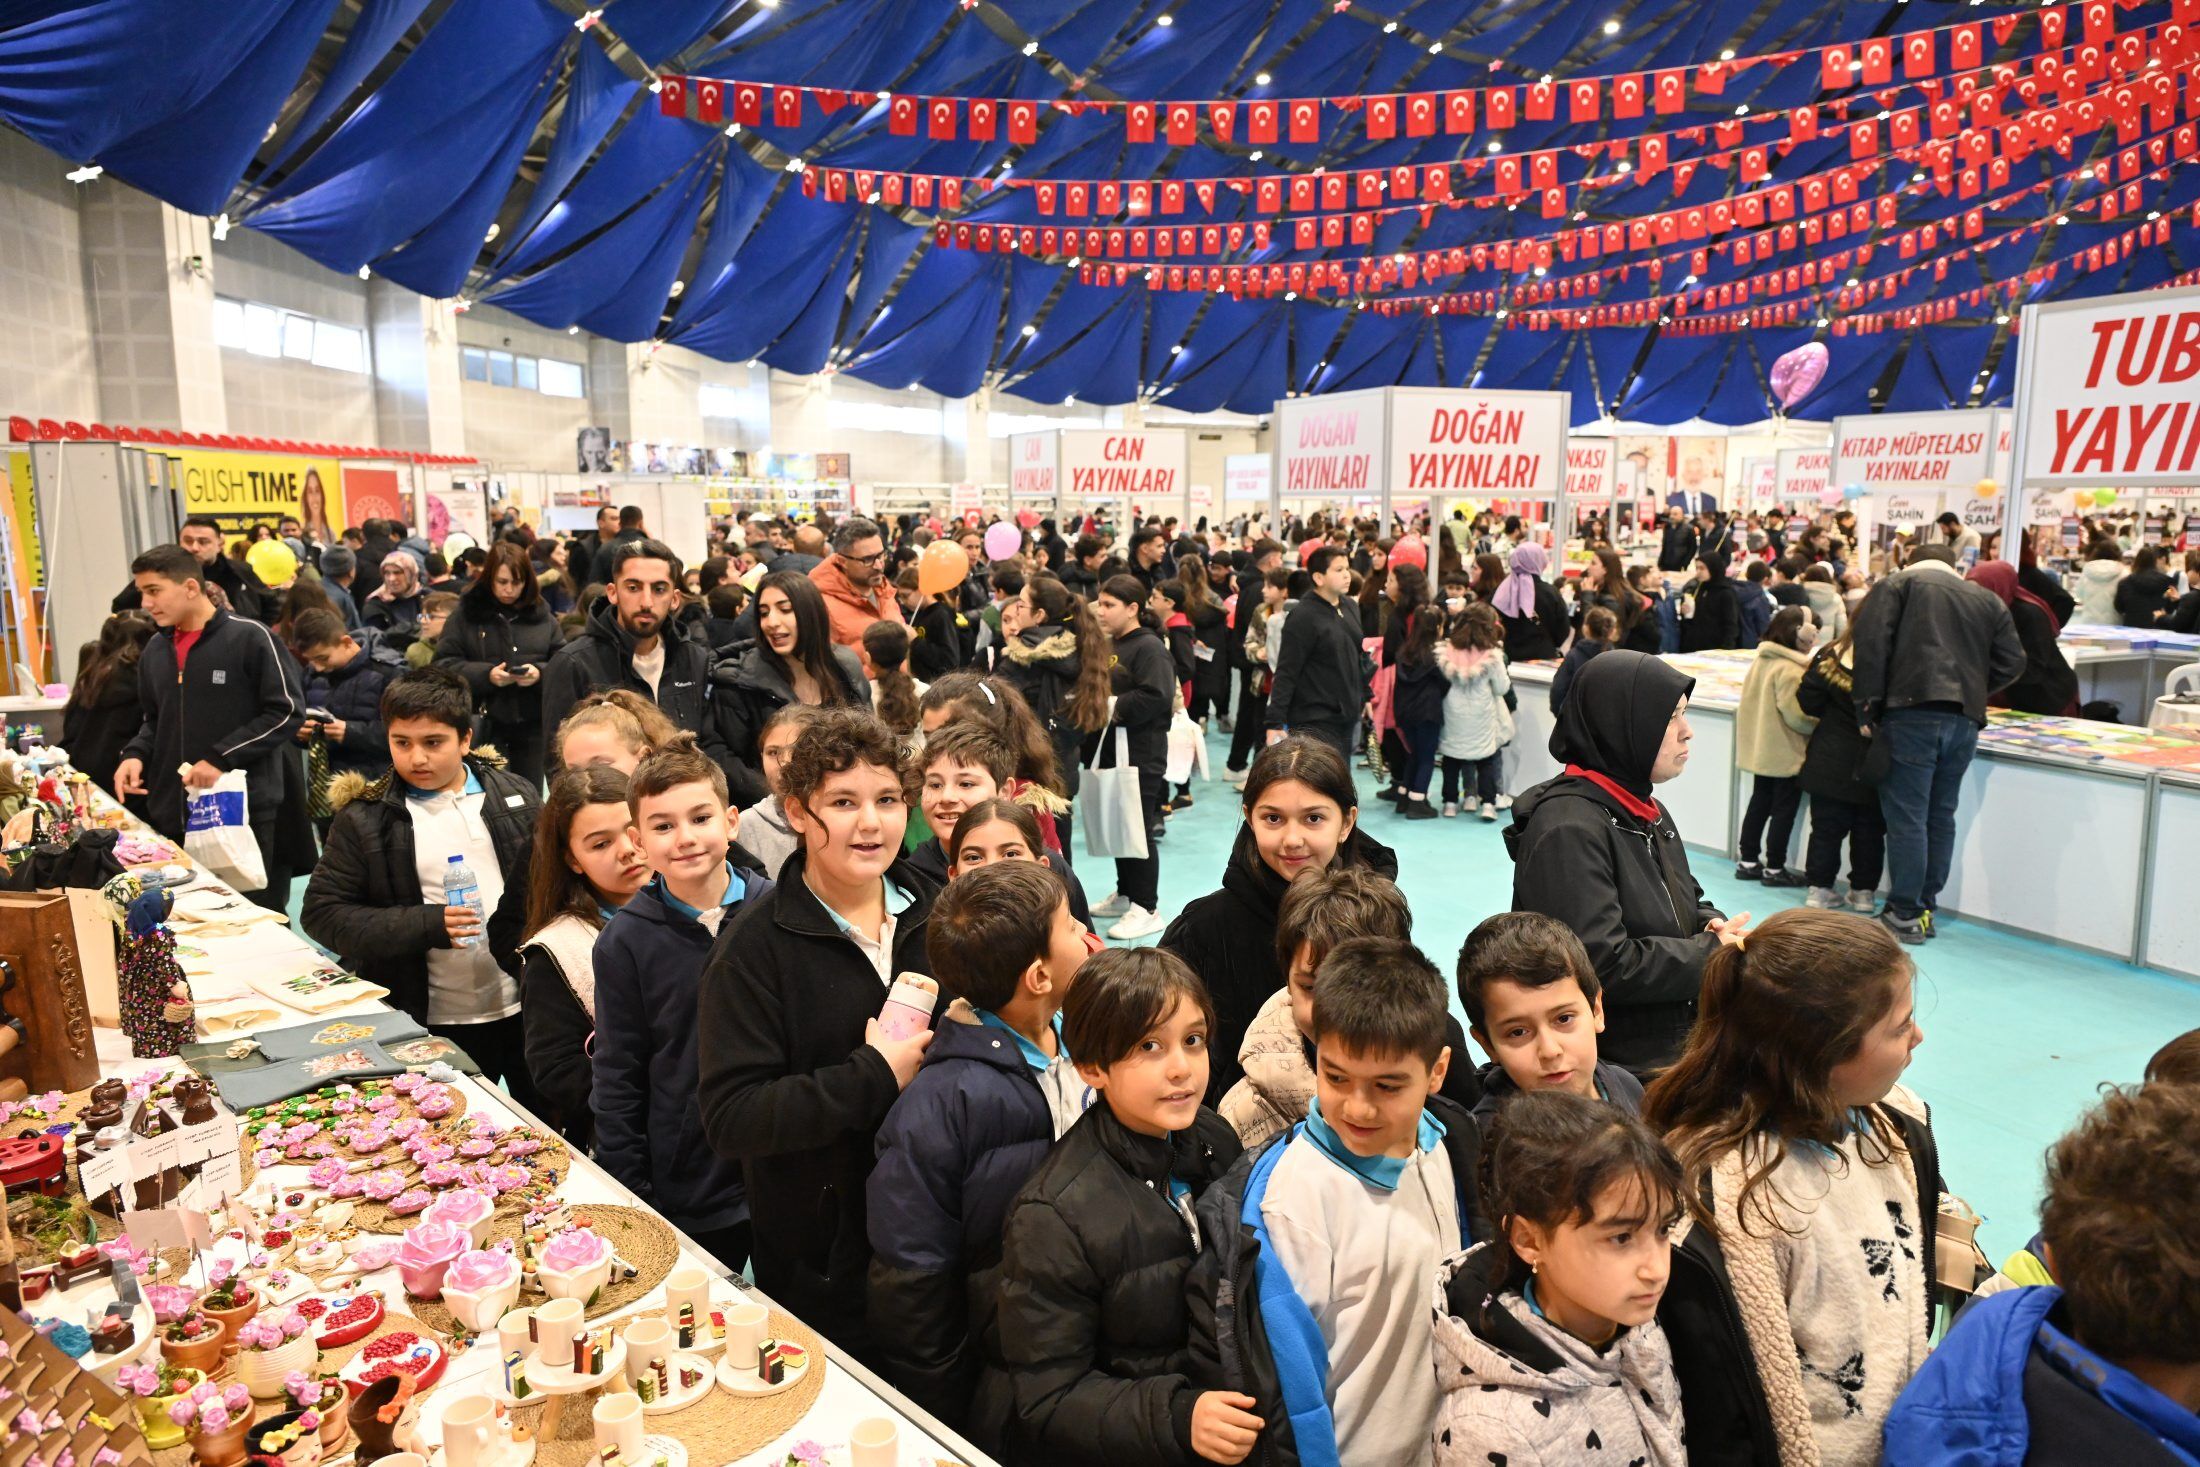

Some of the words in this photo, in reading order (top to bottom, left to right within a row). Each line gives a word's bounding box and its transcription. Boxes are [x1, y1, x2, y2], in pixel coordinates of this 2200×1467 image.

[2085, 311, 2200, 389] TUB
[1429, 402, 1524, 445] DOĞAN
[1025, 436, 1042, 462] CAN
[1103, 437, 1145, 462] CAN
[1840, 437, 1887, 458] KİTAP
[1889, 431, 1984, 457] MÜPTELASI
[1013, 467, 1054, 492] YAYINLARI
[1072, 467, 1175, 492] YAYINLARI
[1287, 453, 1371, 490] YAYINLARI
[1408, 452, 1541, 489] YAYINLARI
[1865, 459, 1950, 481] YAYINLARI
[186, 467, 246, 503] GLISH
[248, 470, 298, 503] TIME
[1887, 508, 1924, 521] ŞAHİN
